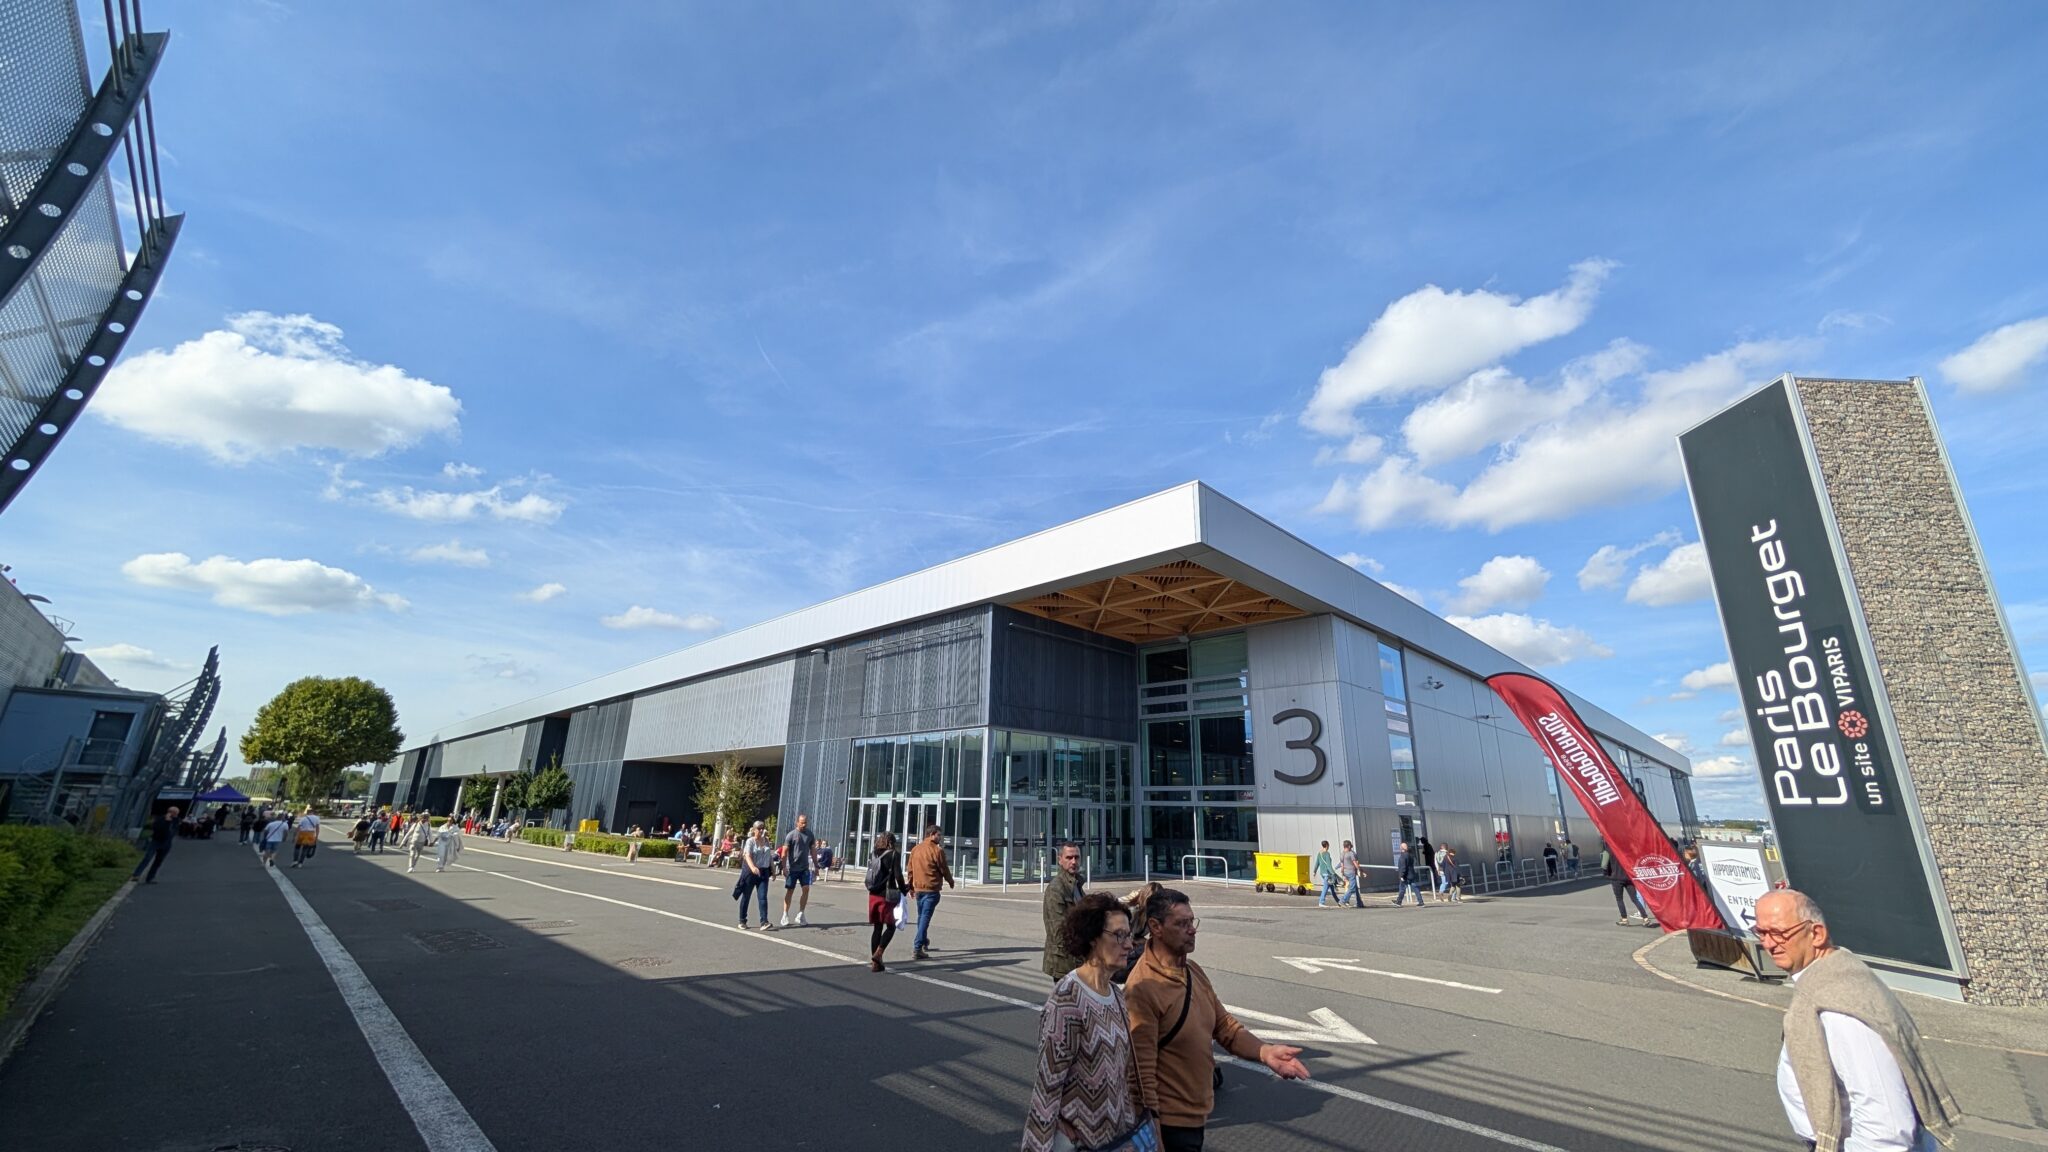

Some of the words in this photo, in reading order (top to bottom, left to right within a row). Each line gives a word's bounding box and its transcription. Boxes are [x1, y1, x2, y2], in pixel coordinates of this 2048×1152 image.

[1751, 519, 1830, 731] Bourget
[1823, 637, 1855, 707] VIPARIS
[1272, 709, 1326, 785] 3
[1757, 669, 1812, 805] Paris
[1854, 743, 1874, 777] site
[1810, 742, 1848, 805] Le
[1862, 782, 1882, 804] un
[1711, 863, 1761, 880] HIPPOPOTAMUS
[1727, 895, 1757, 907] ENTRÉ
